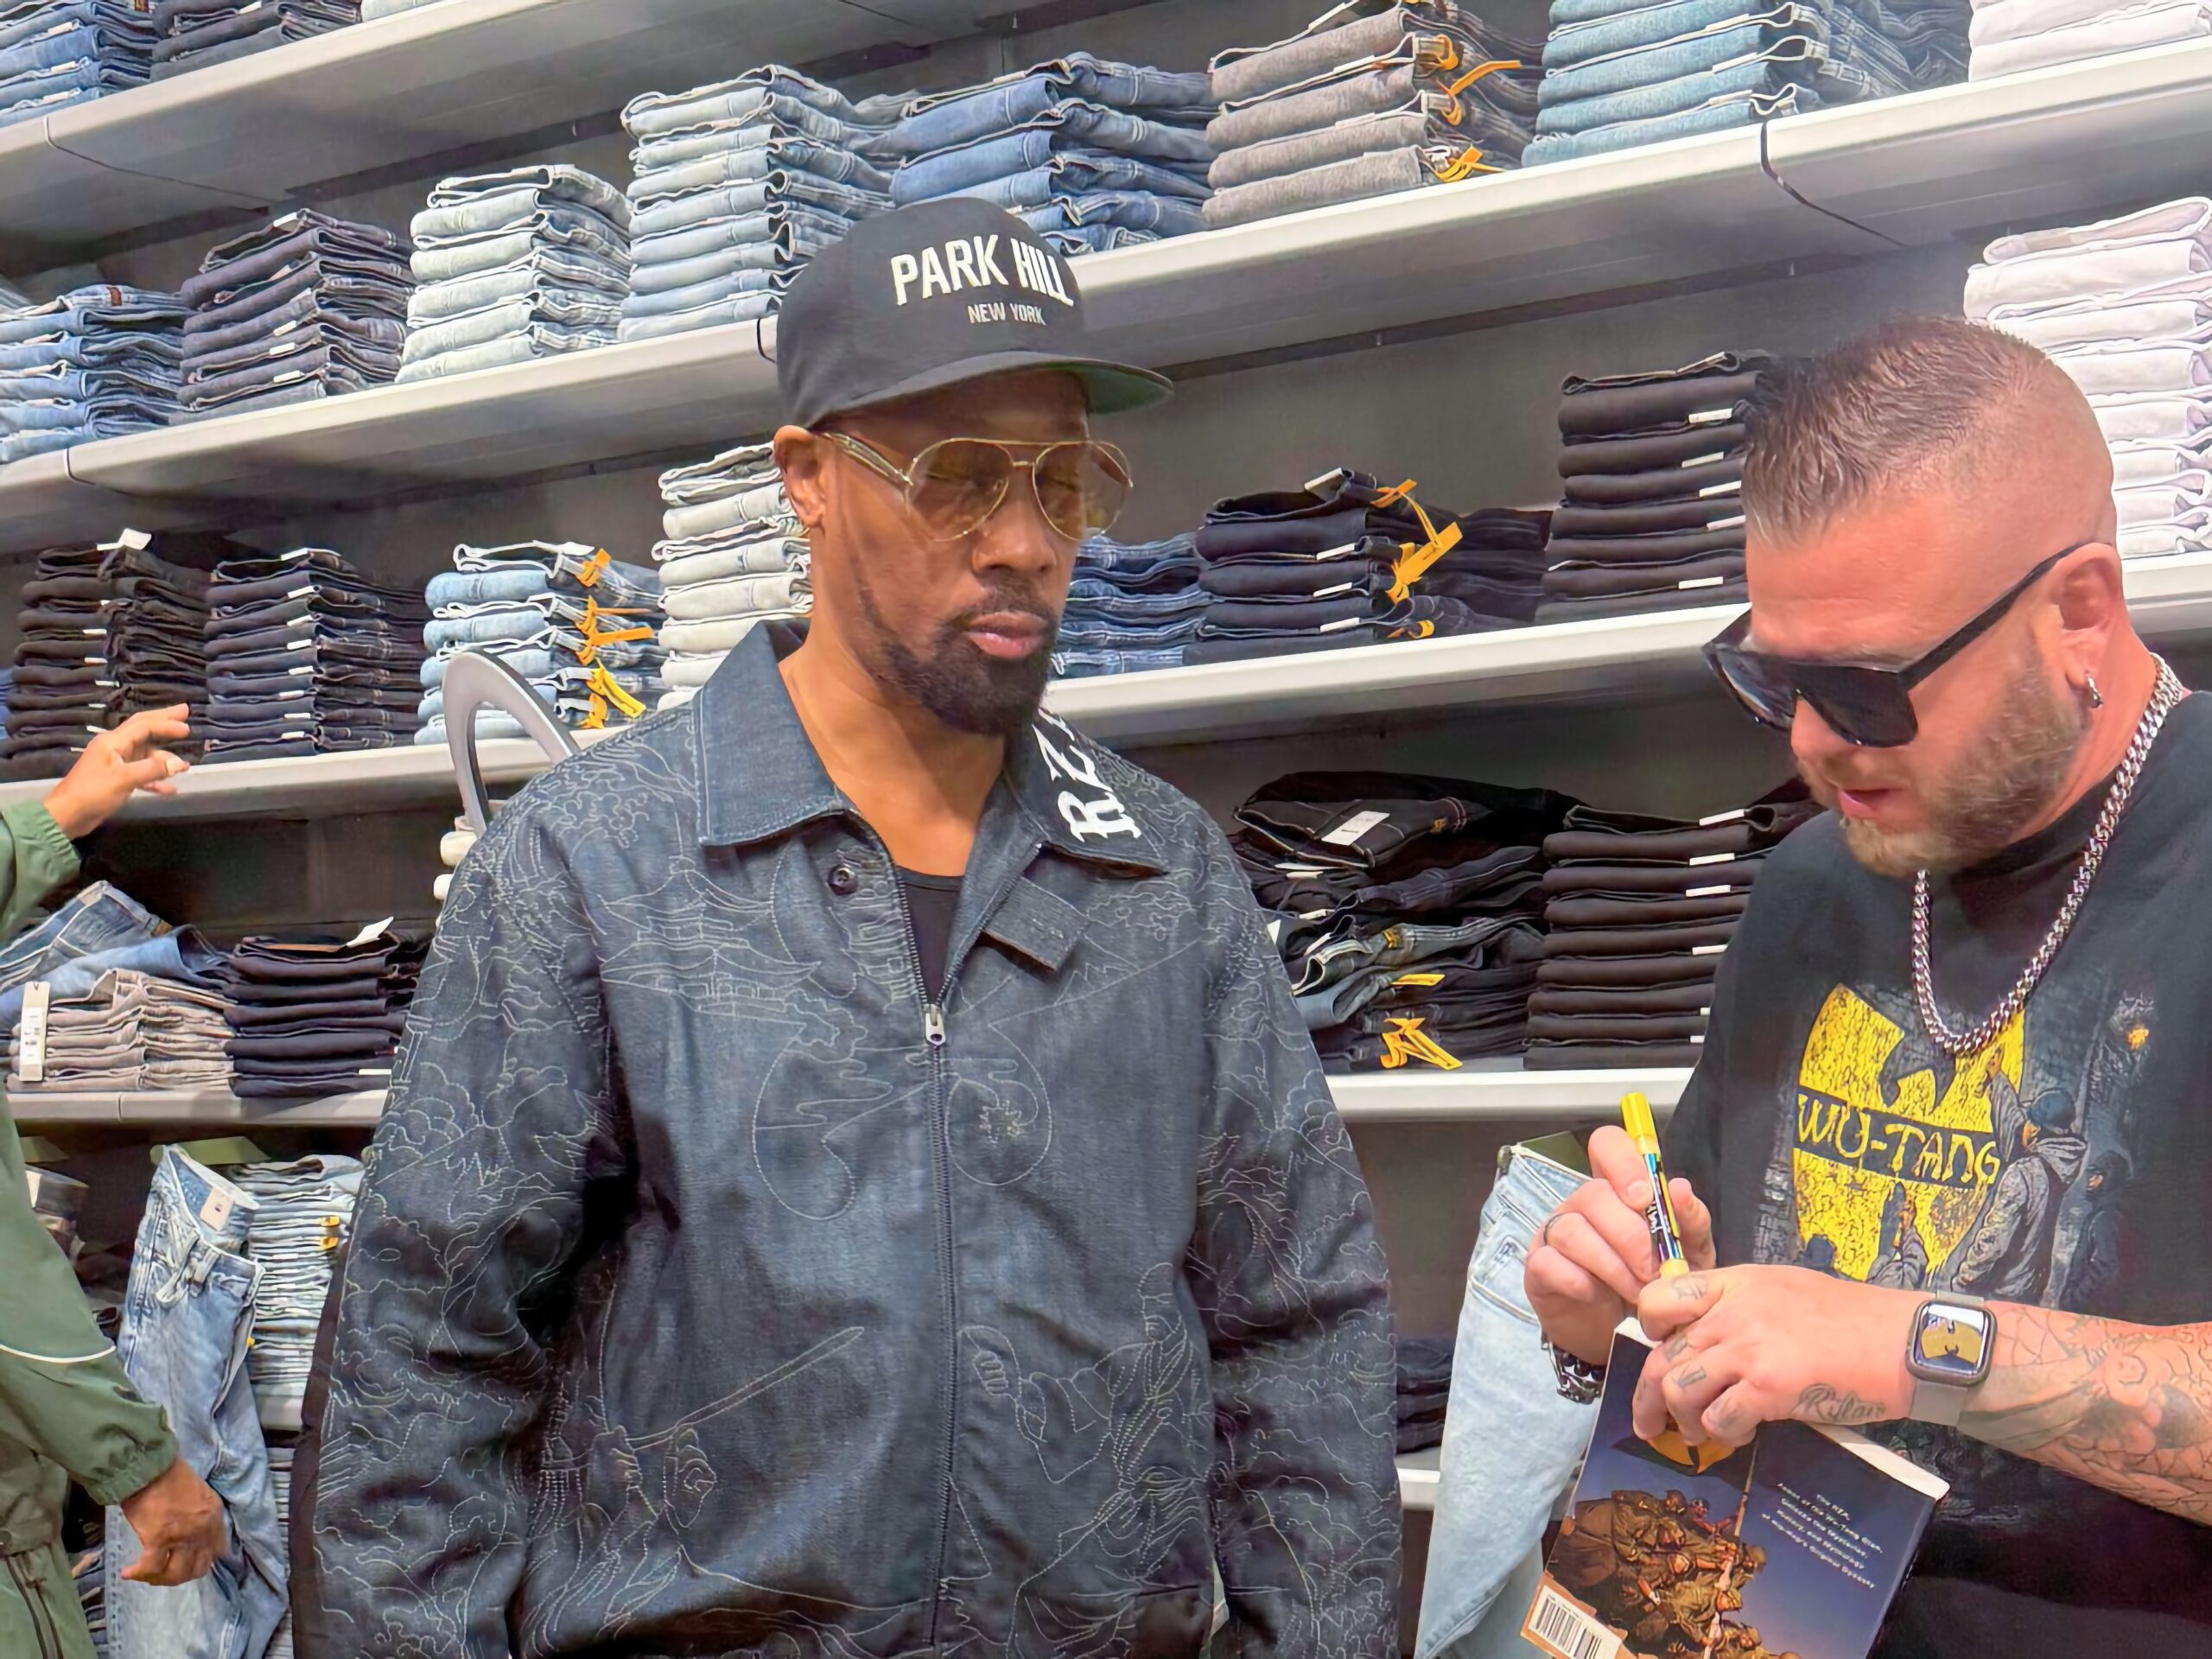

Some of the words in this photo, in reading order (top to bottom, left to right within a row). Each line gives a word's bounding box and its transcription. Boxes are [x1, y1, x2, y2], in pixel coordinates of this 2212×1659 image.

[890, 234, 1009, 306] PARK
[1010, 238, 1074, 307] HILL
[967, 302, 1006, 324] NEW
[1009, 302, 1046, 326] YORK
[1797, 1093, 2001, 1185] WU-TANG
